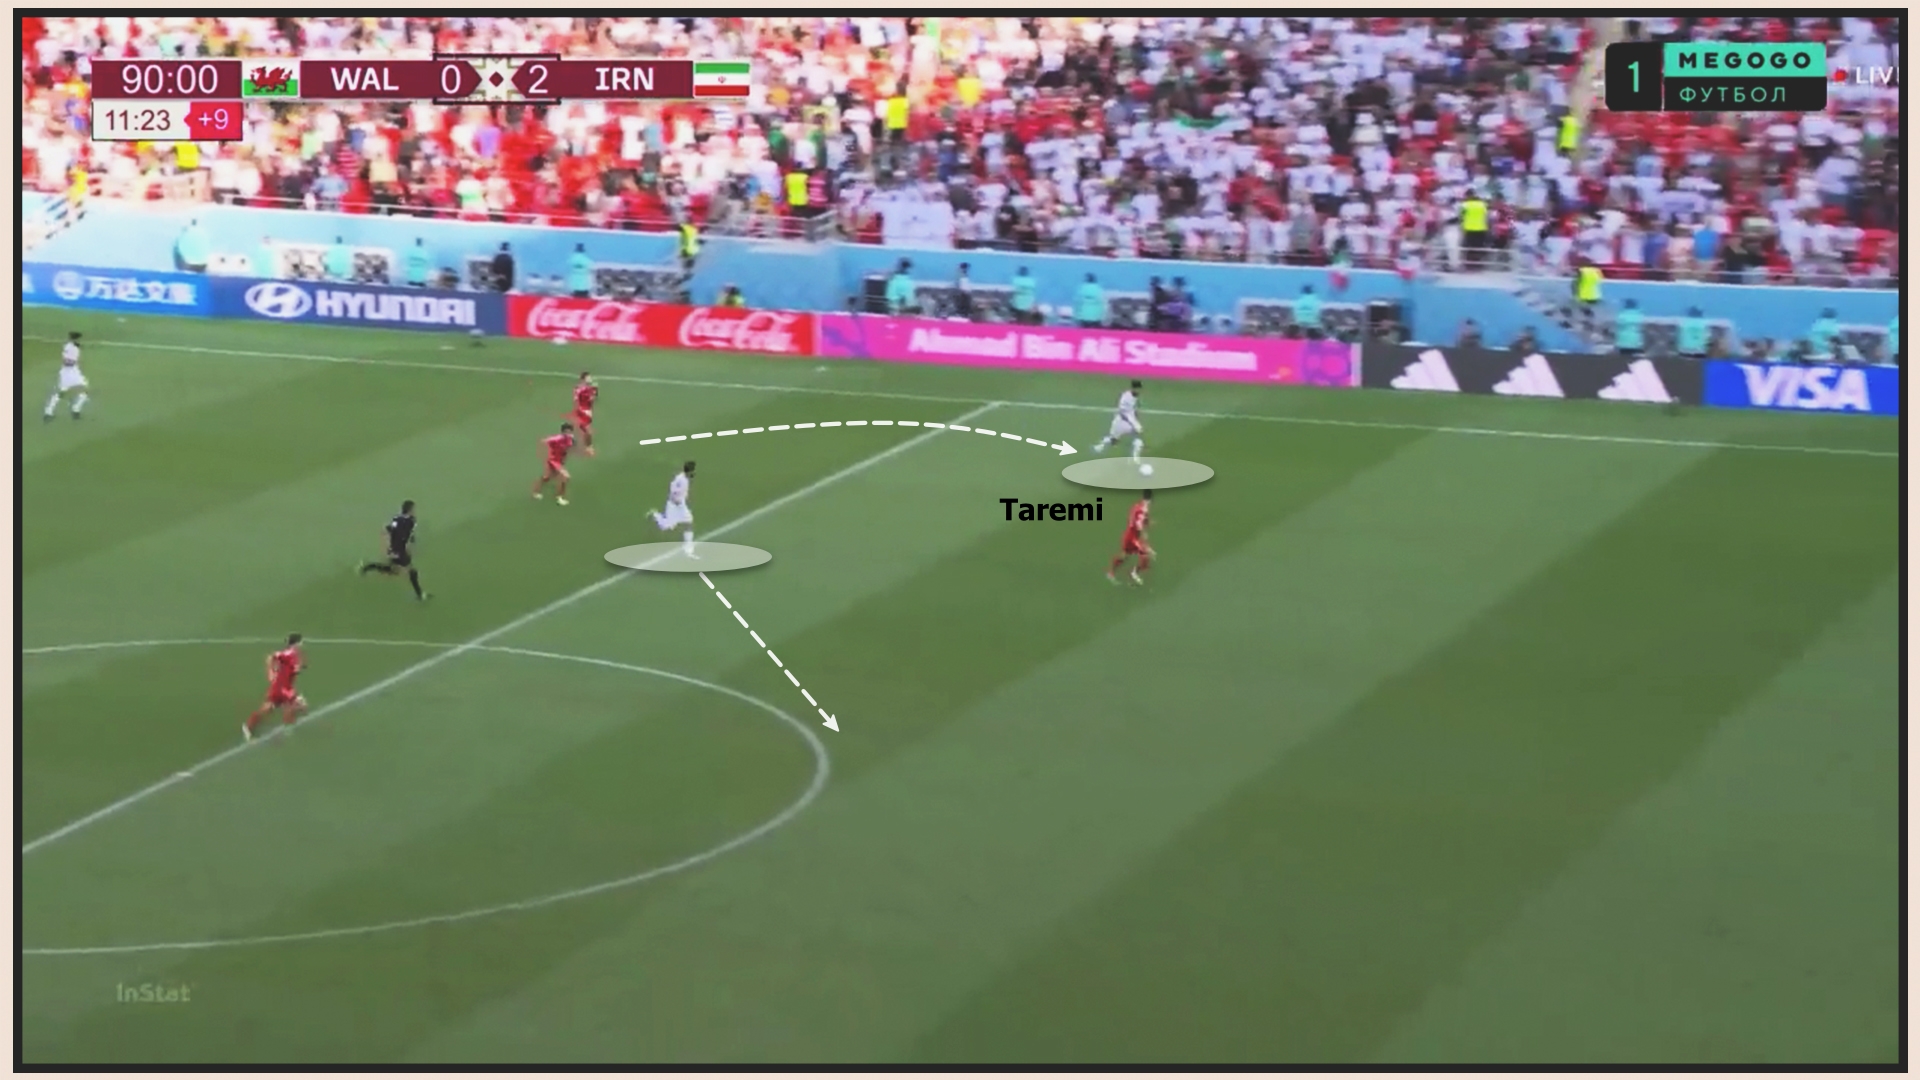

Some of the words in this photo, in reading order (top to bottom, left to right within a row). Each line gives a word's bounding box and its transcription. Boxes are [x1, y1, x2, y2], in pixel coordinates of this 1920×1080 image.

[315, 289, 477, 326] HYUNDAI
[1022, 333, 1074, 361] Bin
[1078, 336, 1121, 364] Ali
[1124, 339, 1258, 371] Stadium
[1733, 363, 1873, 412] VISA
